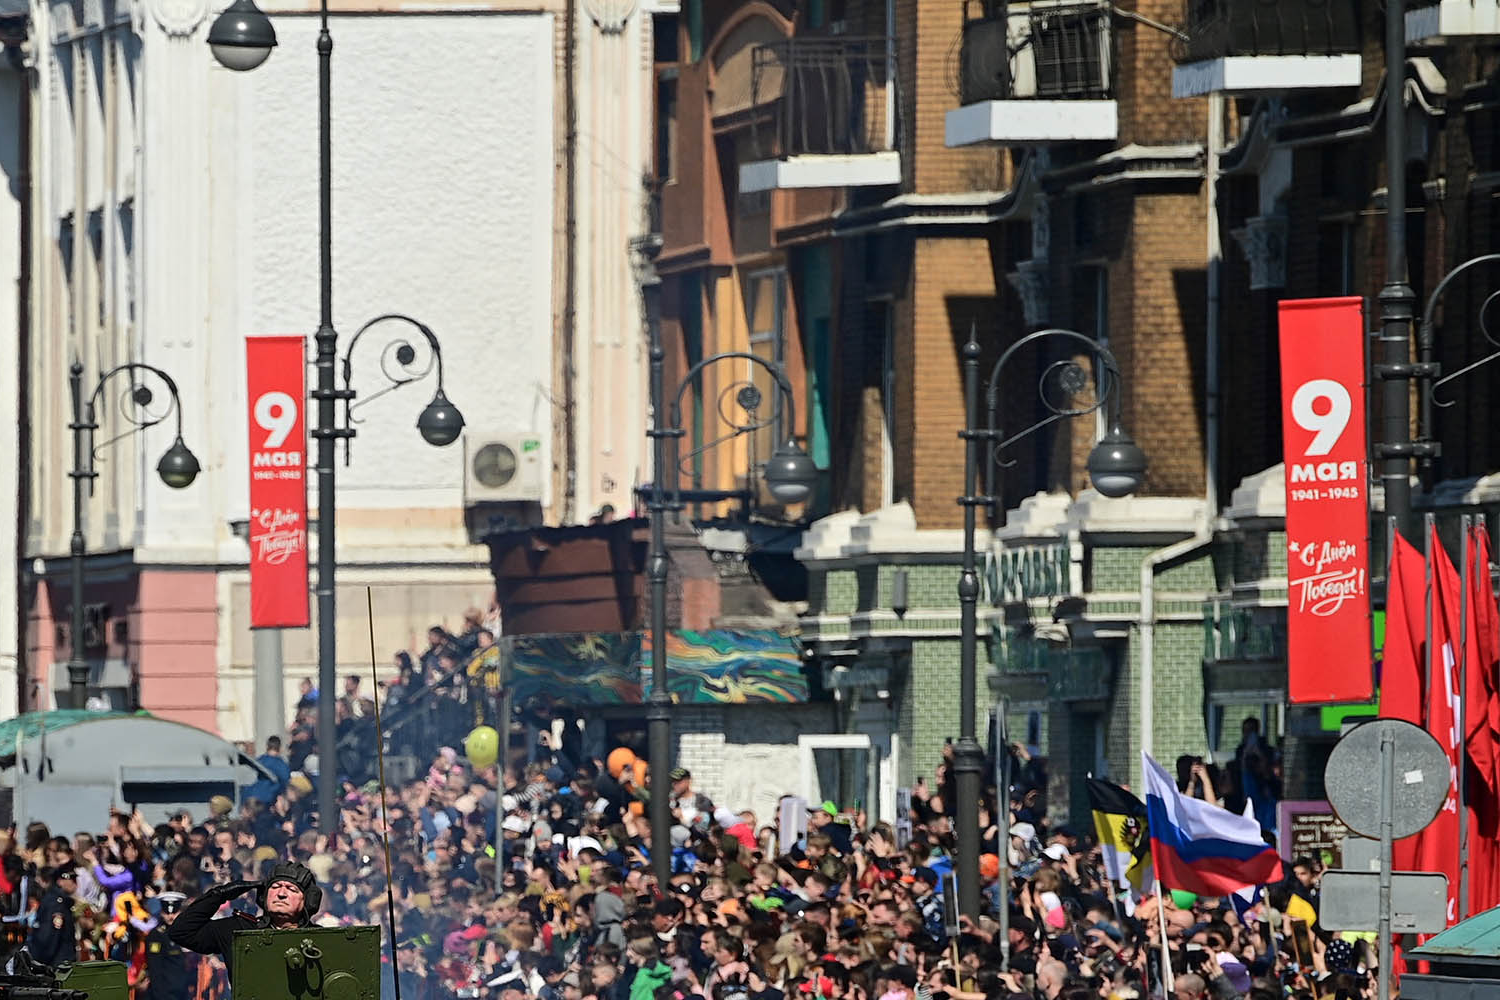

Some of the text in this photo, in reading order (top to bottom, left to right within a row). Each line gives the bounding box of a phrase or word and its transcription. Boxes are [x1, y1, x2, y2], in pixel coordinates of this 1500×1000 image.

[254, 391, 298, 449] 9
[1291, 379, 1352, 457] 9
[1290, 461, 1358, 483] мая
[1291, 487, 1359, 501] 1941-1945
[1300, 539, 1357, 574] С Днём
[1290, 567, 1365, 616] Победы!
